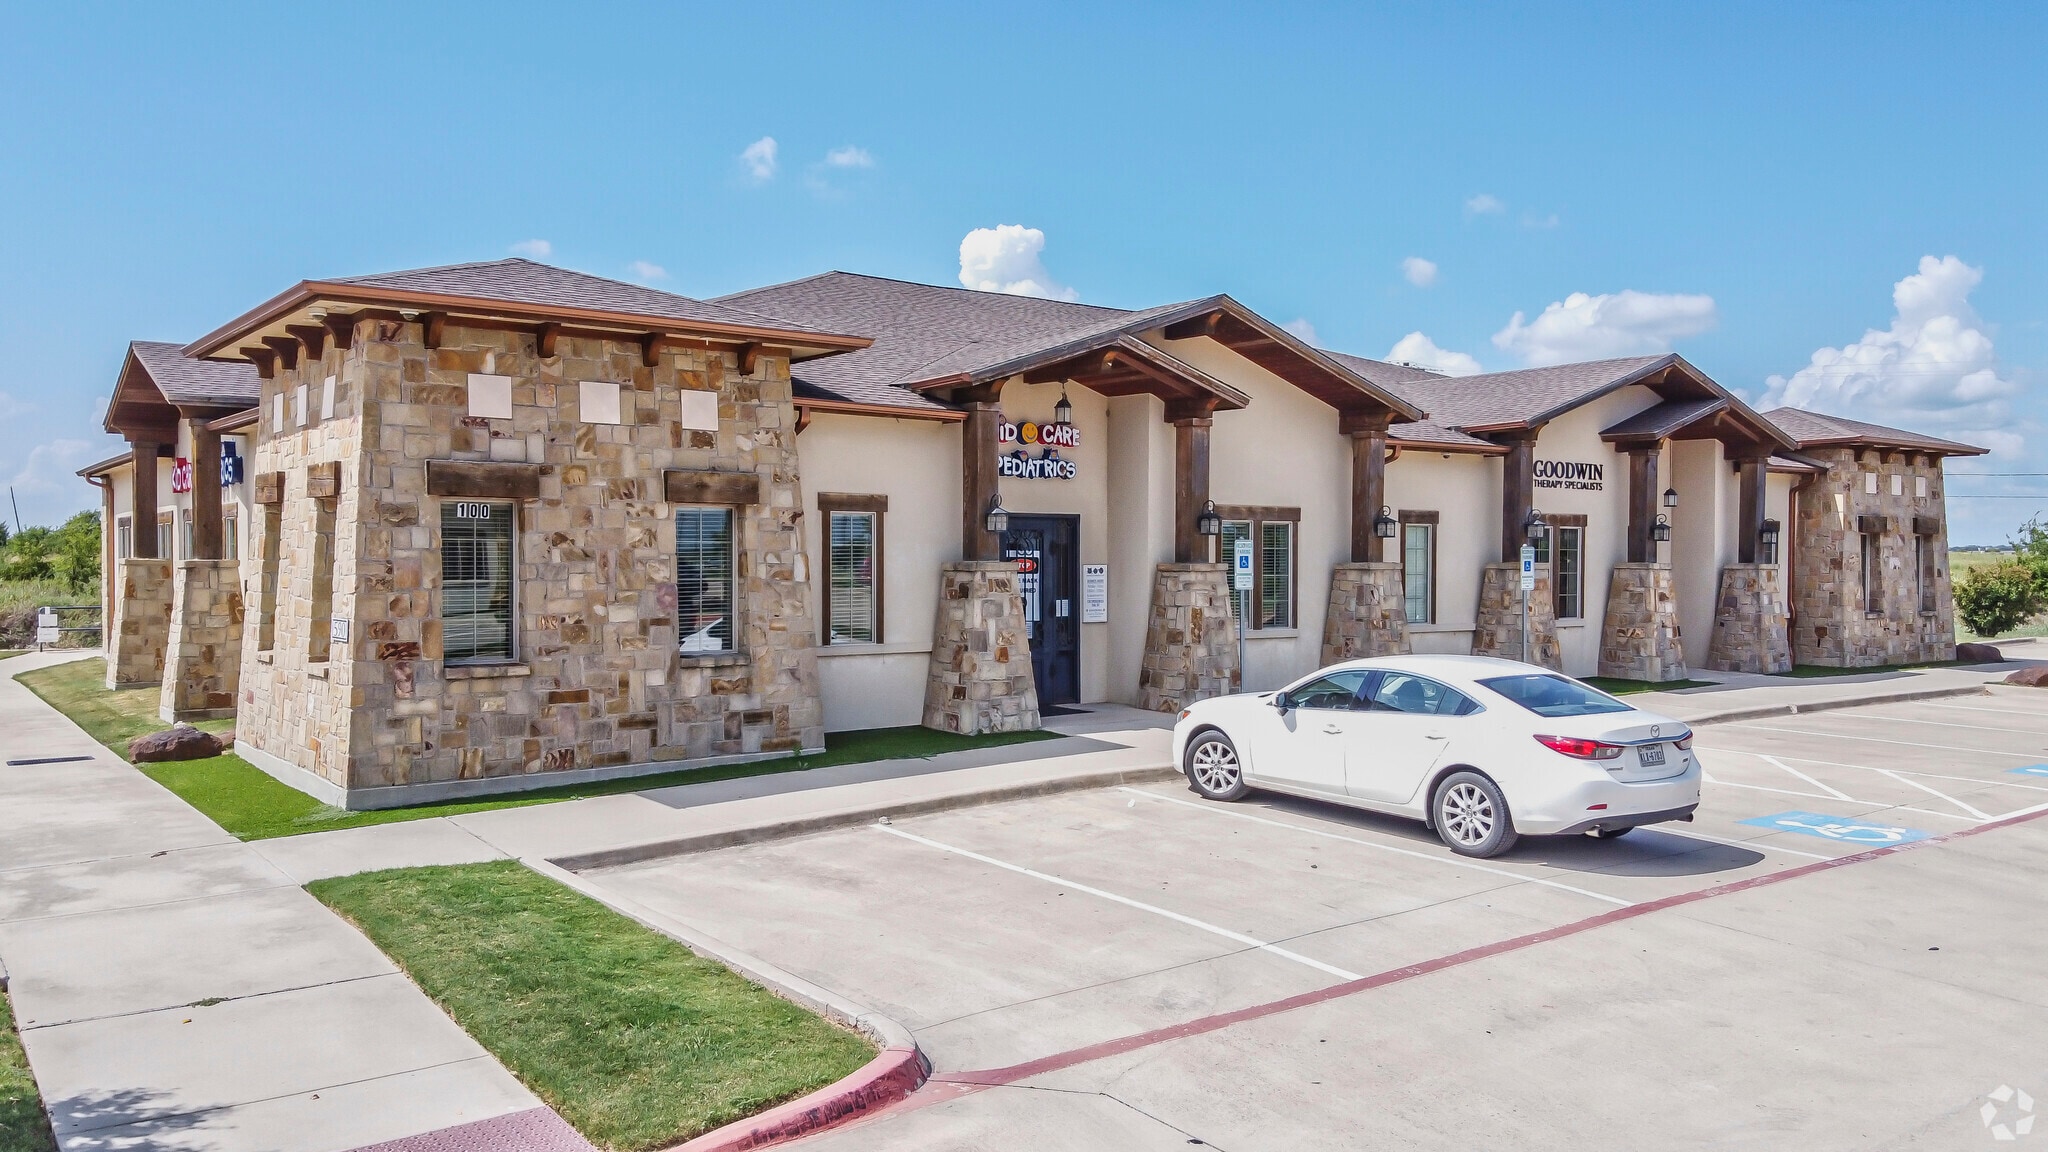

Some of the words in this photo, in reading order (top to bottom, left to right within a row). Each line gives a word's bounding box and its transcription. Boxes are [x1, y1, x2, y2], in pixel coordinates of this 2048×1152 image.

[1000, 423, 1017, 441] ID
[1043, 425, 1080, 446] CARE
[1533, 460, 1603, 480] GOODWIN
[1534, 479, 1563, 489] THERAPY
[1565, 481, 1603, 491] SPECIALISTS
[459, 503, 489, 518] 100
